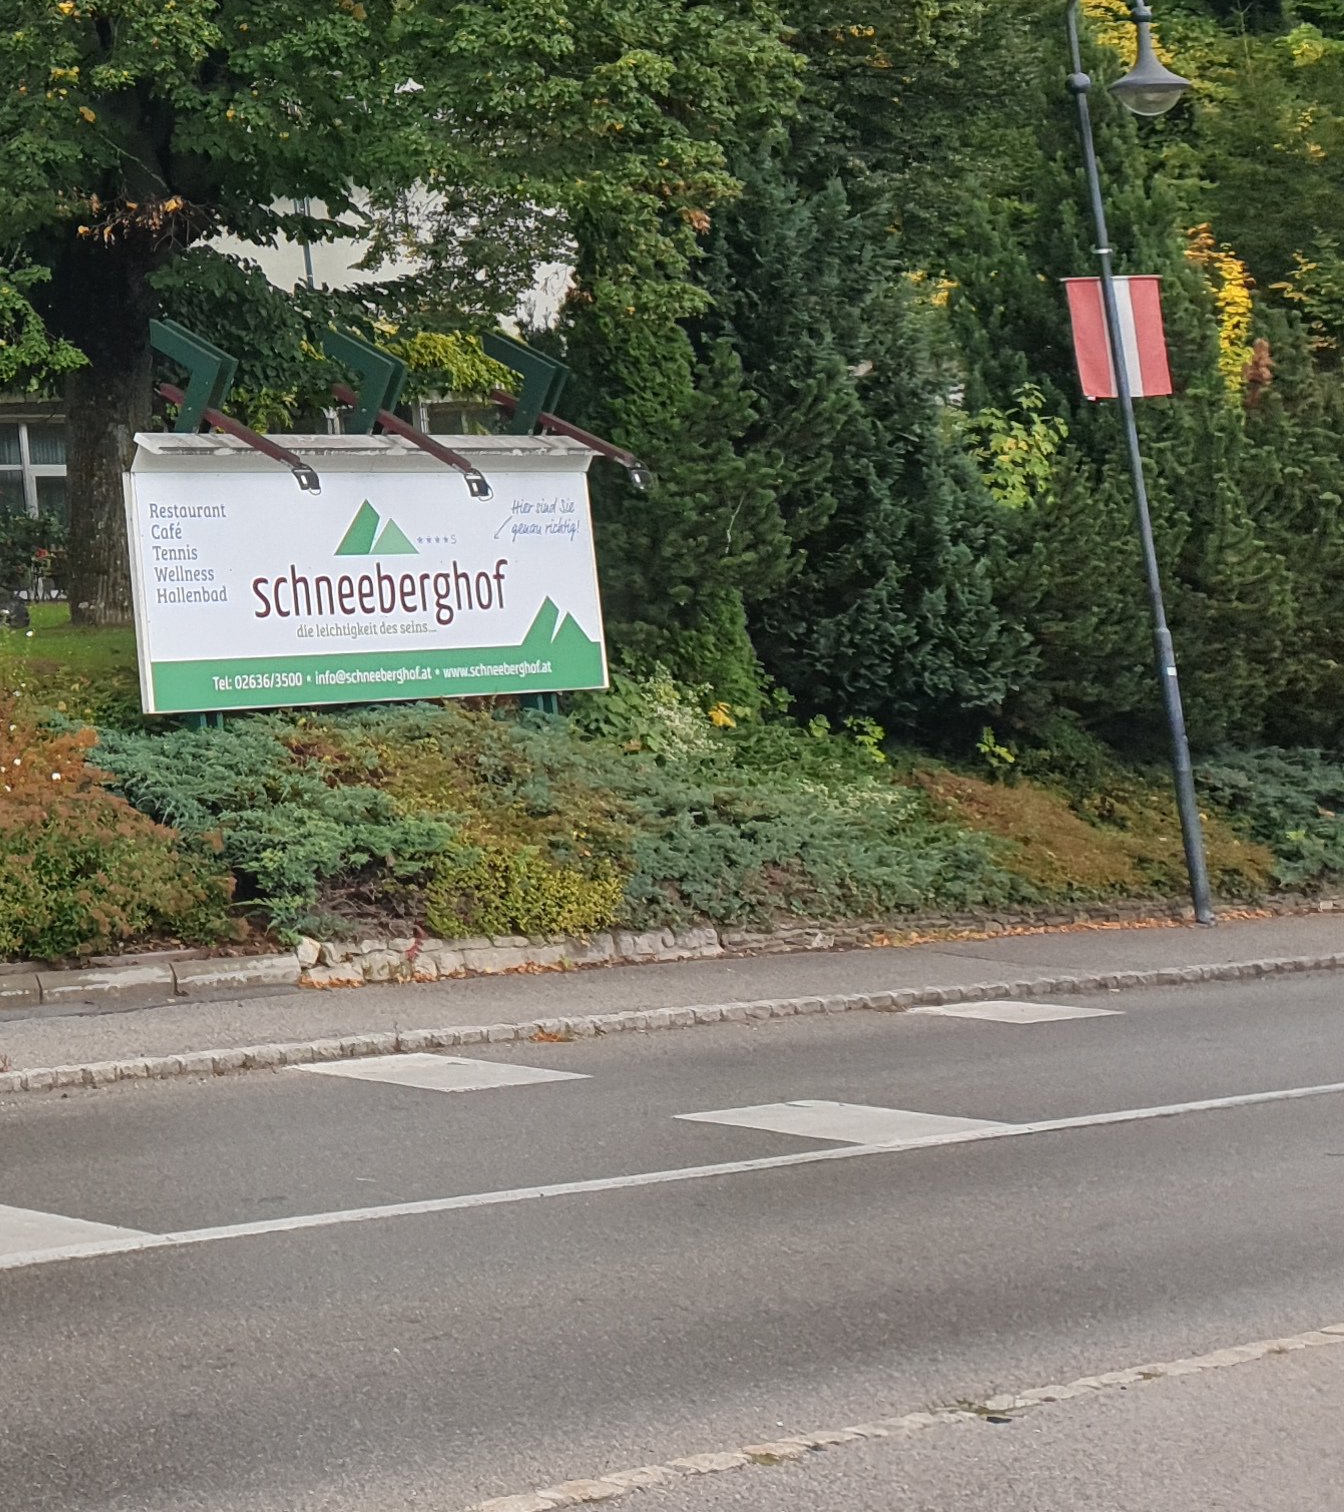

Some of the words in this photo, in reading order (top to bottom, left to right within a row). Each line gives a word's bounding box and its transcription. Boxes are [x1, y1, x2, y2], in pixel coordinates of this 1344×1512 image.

[149, 503, 227, 519] Restaurant
[511, 499, 534, 515] Hier
[535, 497, 558, 514] sind
[151, 521, 182, 540] Café
[511, 523, 542, 543] genau
[545, 517, 580, 542] richtig!
[152, 544, 198, 561] Tennis
[154, 565, 215, 582] Wellness
[156, 585, 228, 604] Hallenbad
[252, 558, 508, 625] schneeberghof
[296, 624, 314, 638] die
[316, 622, 378, 639] leichtigkeit
[379, 621, 398, 634] des
[234, 672, 303, 689] 02636/3500
[315, 665, 432, 685] info@schneeberghof.at
[443, 660, 552, 679] www.schneeberghof.at
